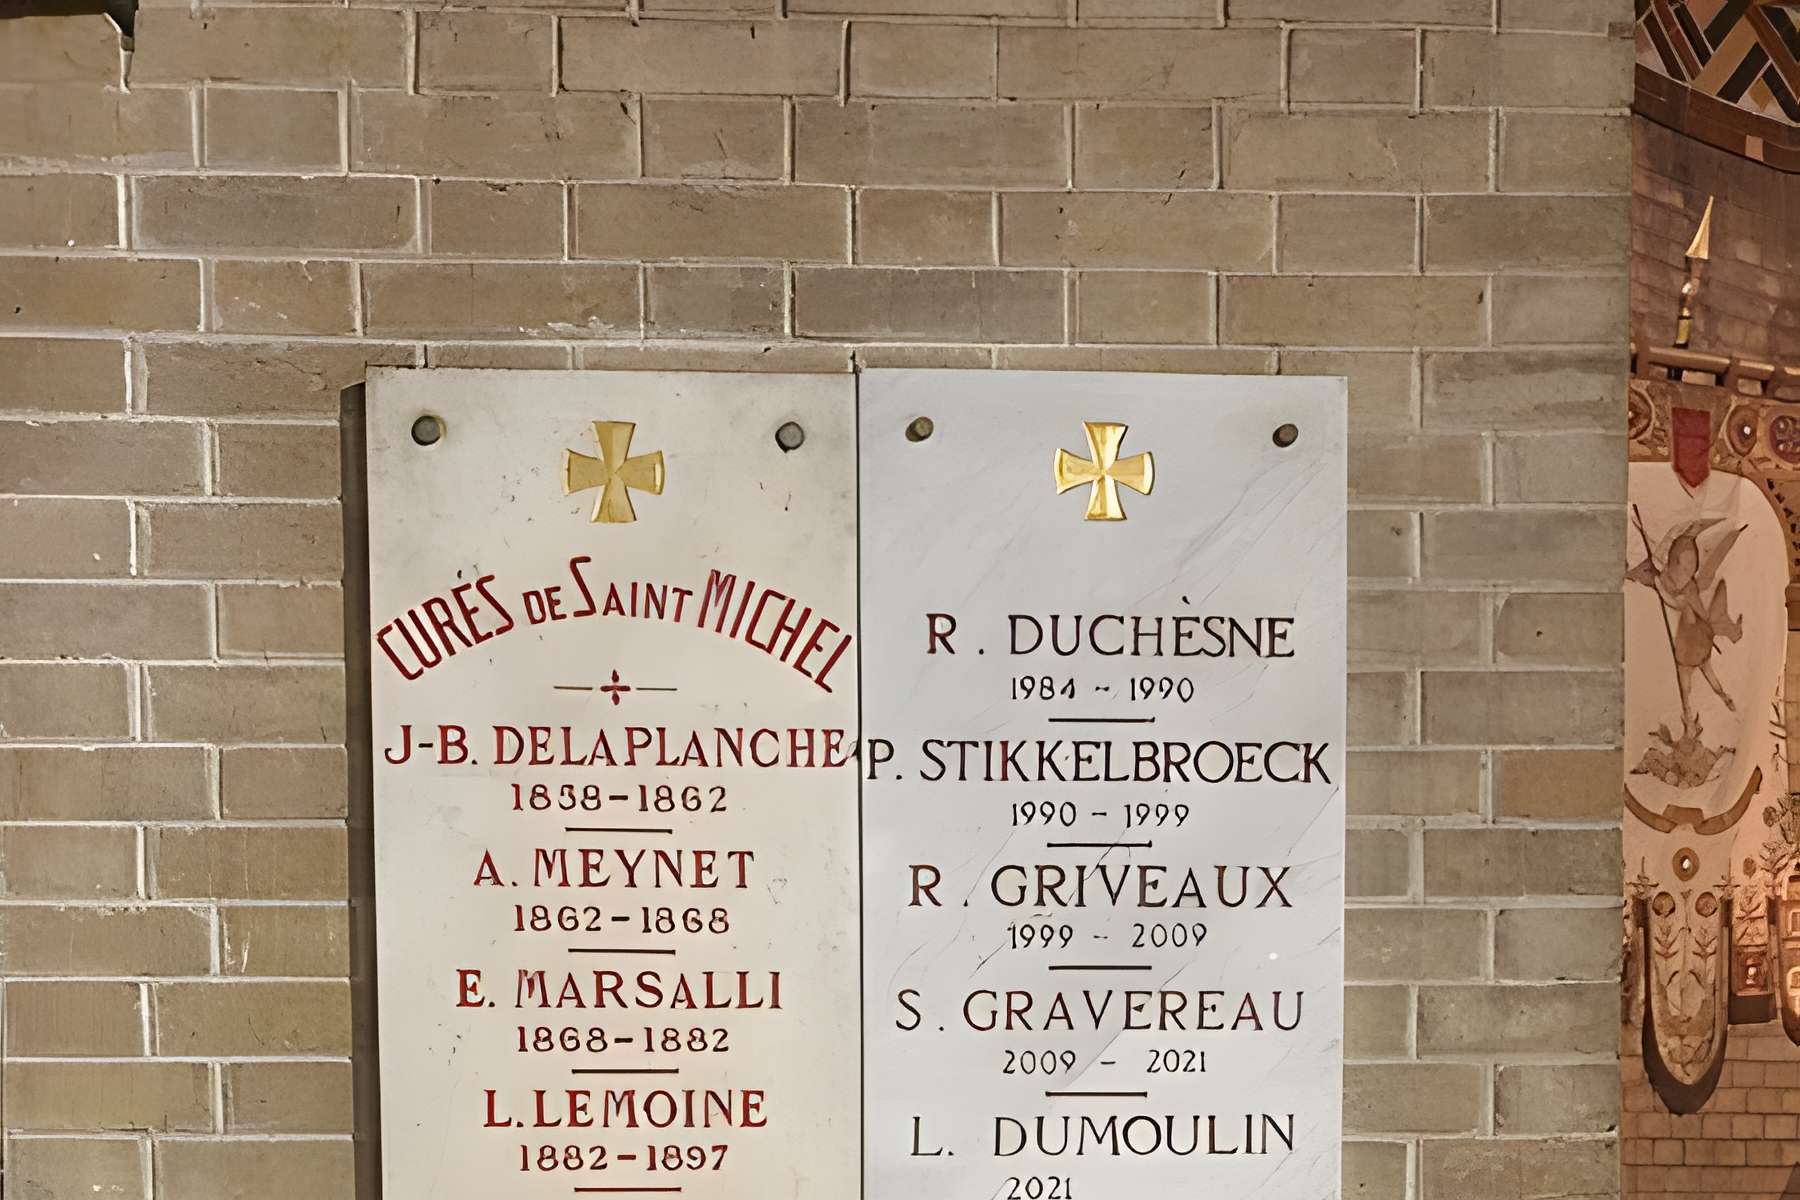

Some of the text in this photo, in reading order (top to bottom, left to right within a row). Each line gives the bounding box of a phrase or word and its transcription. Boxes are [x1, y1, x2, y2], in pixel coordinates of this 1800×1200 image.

[376, 556, 853, 694] CURÉS DE SAINT MICHEL
[1008, 596, 1296, 658] DUCHÈSNE
[384, 725, 849, 768] J-B. DELAPLANCHE
[867, 739, 1331, 784] P. STIKKELBROECK
[474, 848, 755, 888] A. MEYNET
[991, 864, 1293, 909] GRIVEAUX
[456, 969, 783, 1009] E. MARSALLI
[896, 989, 1305, 1032] S. GRAVEREAU
[911, 1114, 1295, 1156] L. DUMOULIN
[1006, 1175, 1073, 1200] 2021
